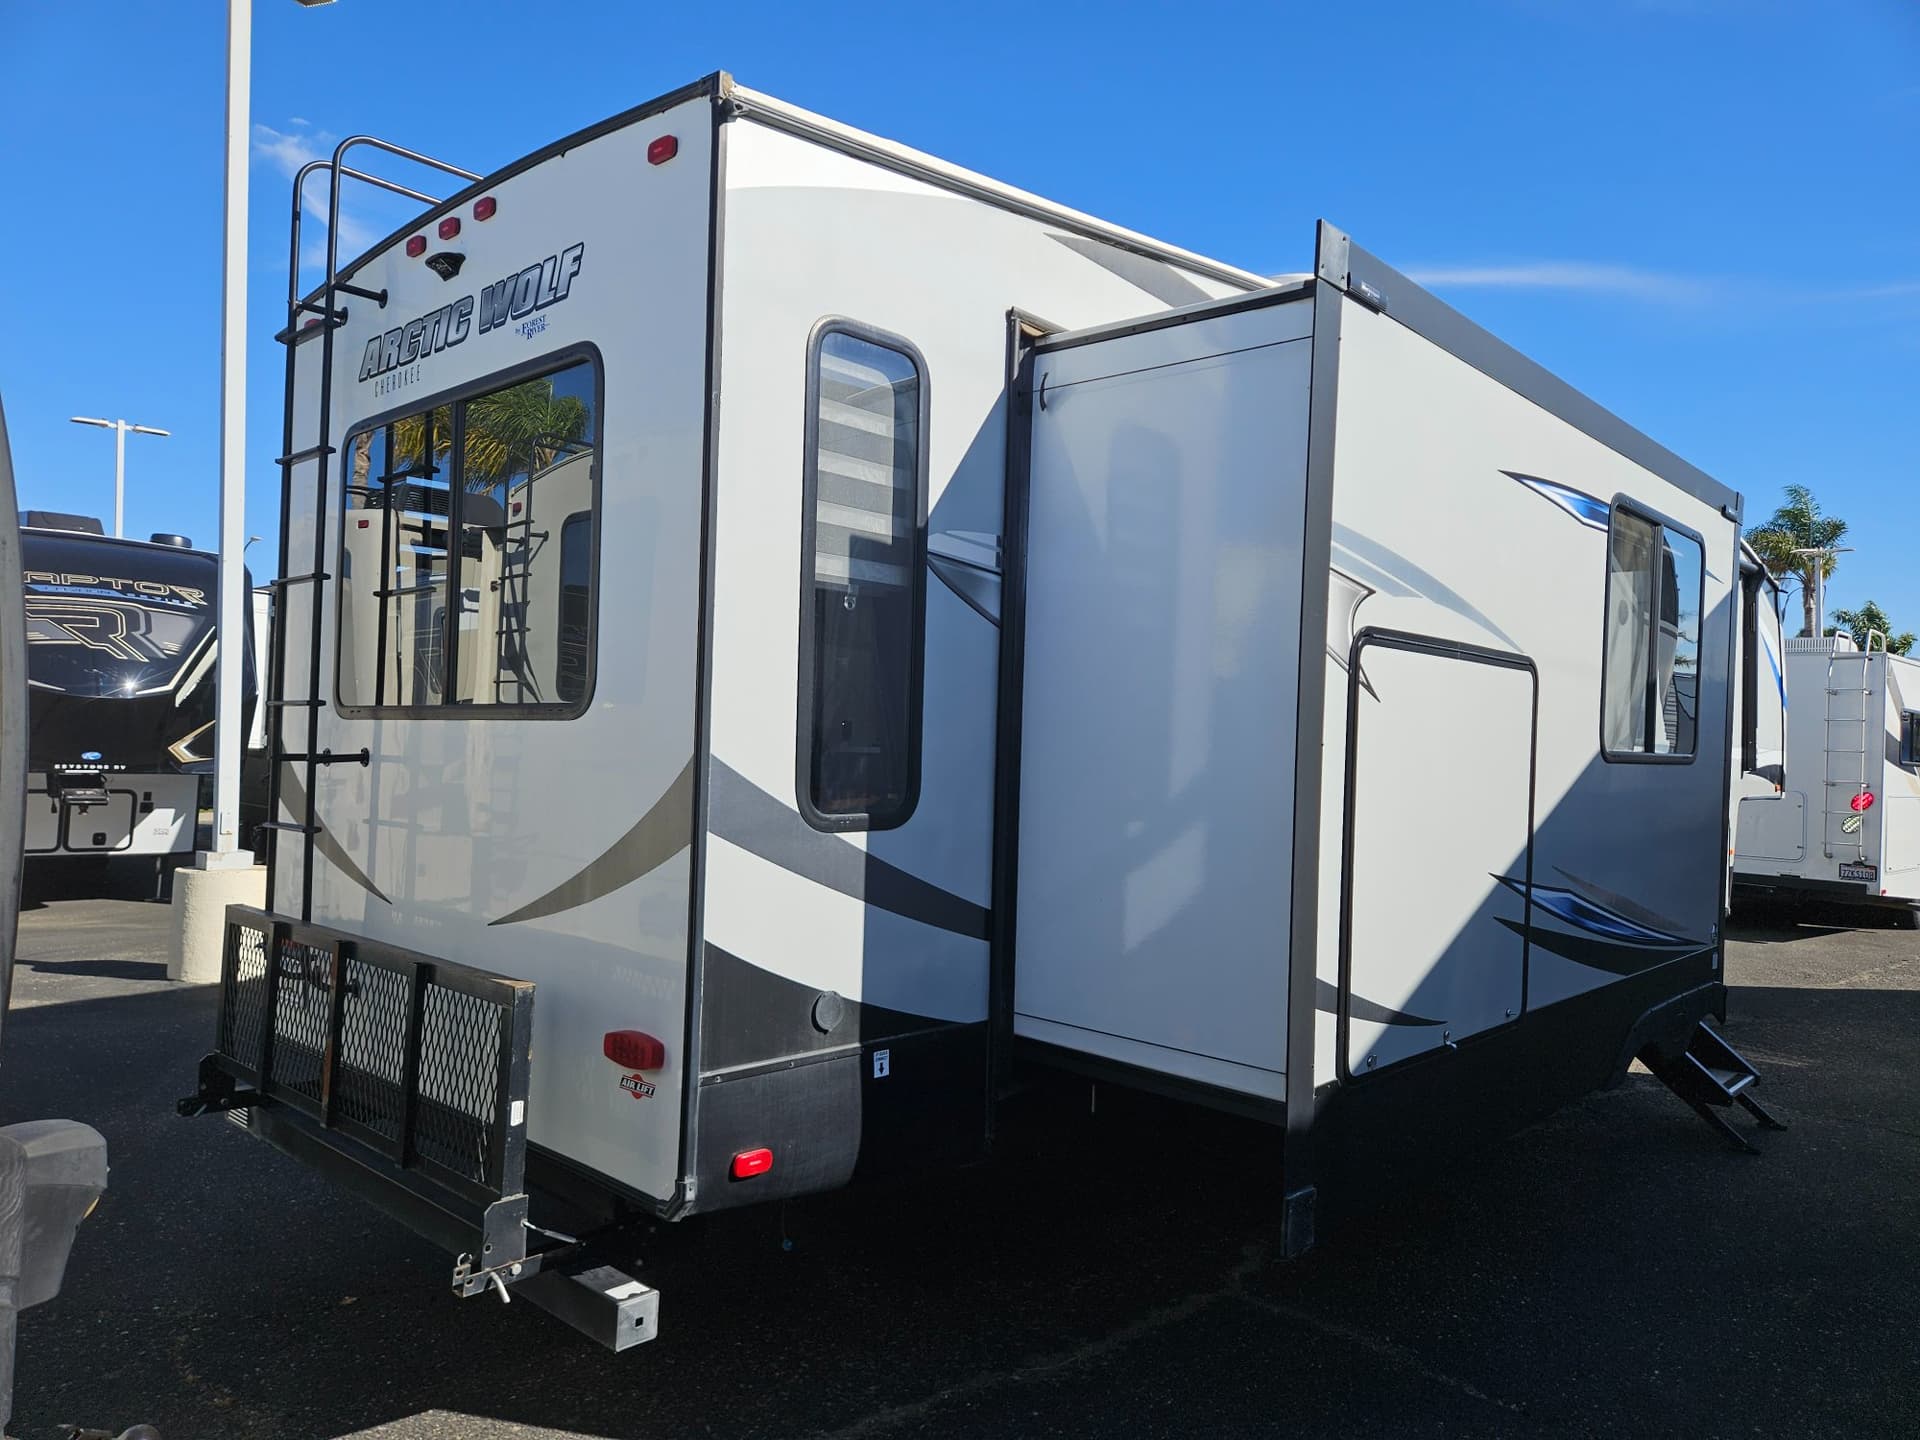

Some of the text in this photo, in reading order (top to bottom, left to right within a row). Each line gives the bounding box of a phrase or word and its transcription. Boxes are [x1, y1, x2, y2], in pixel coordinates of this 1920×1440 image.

[358, 242, 584, 382] ARCTIC WOLF
[375, 364, 420, 398] CHEROKEE
[24, 571, 207, 605] APTOR
[621, 1078, 654, 1095] AIR LIFT
